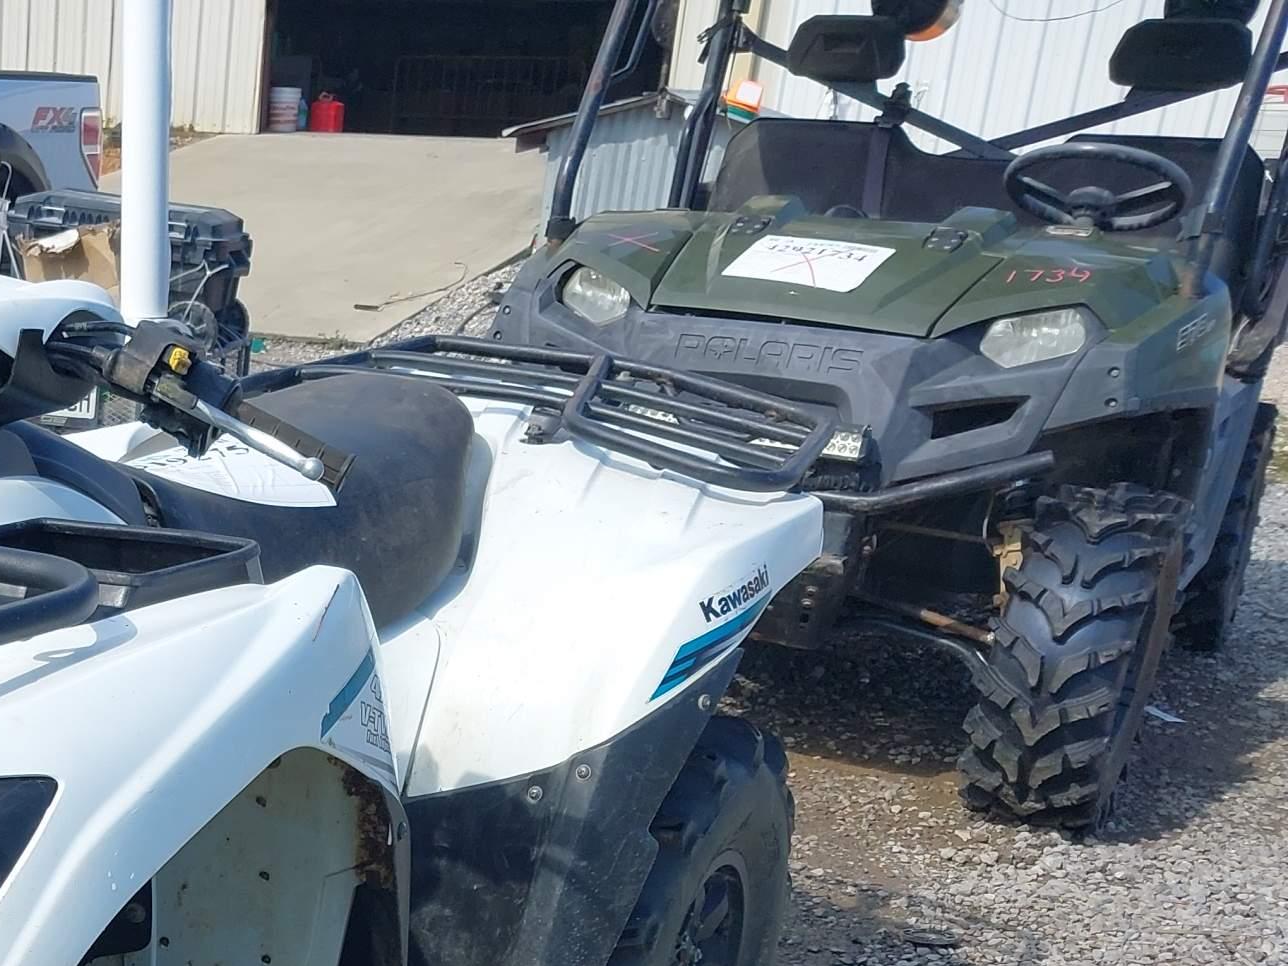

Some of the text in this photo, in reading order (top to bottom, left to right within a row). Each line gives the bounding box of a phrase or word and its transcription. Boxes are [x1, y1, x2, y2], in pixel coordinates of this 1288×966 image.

[1006, 266, 1091, 284] 1734
[675, 333, 865, 377] POLARIS
[698, 563, 770, 623] Kawasaki
